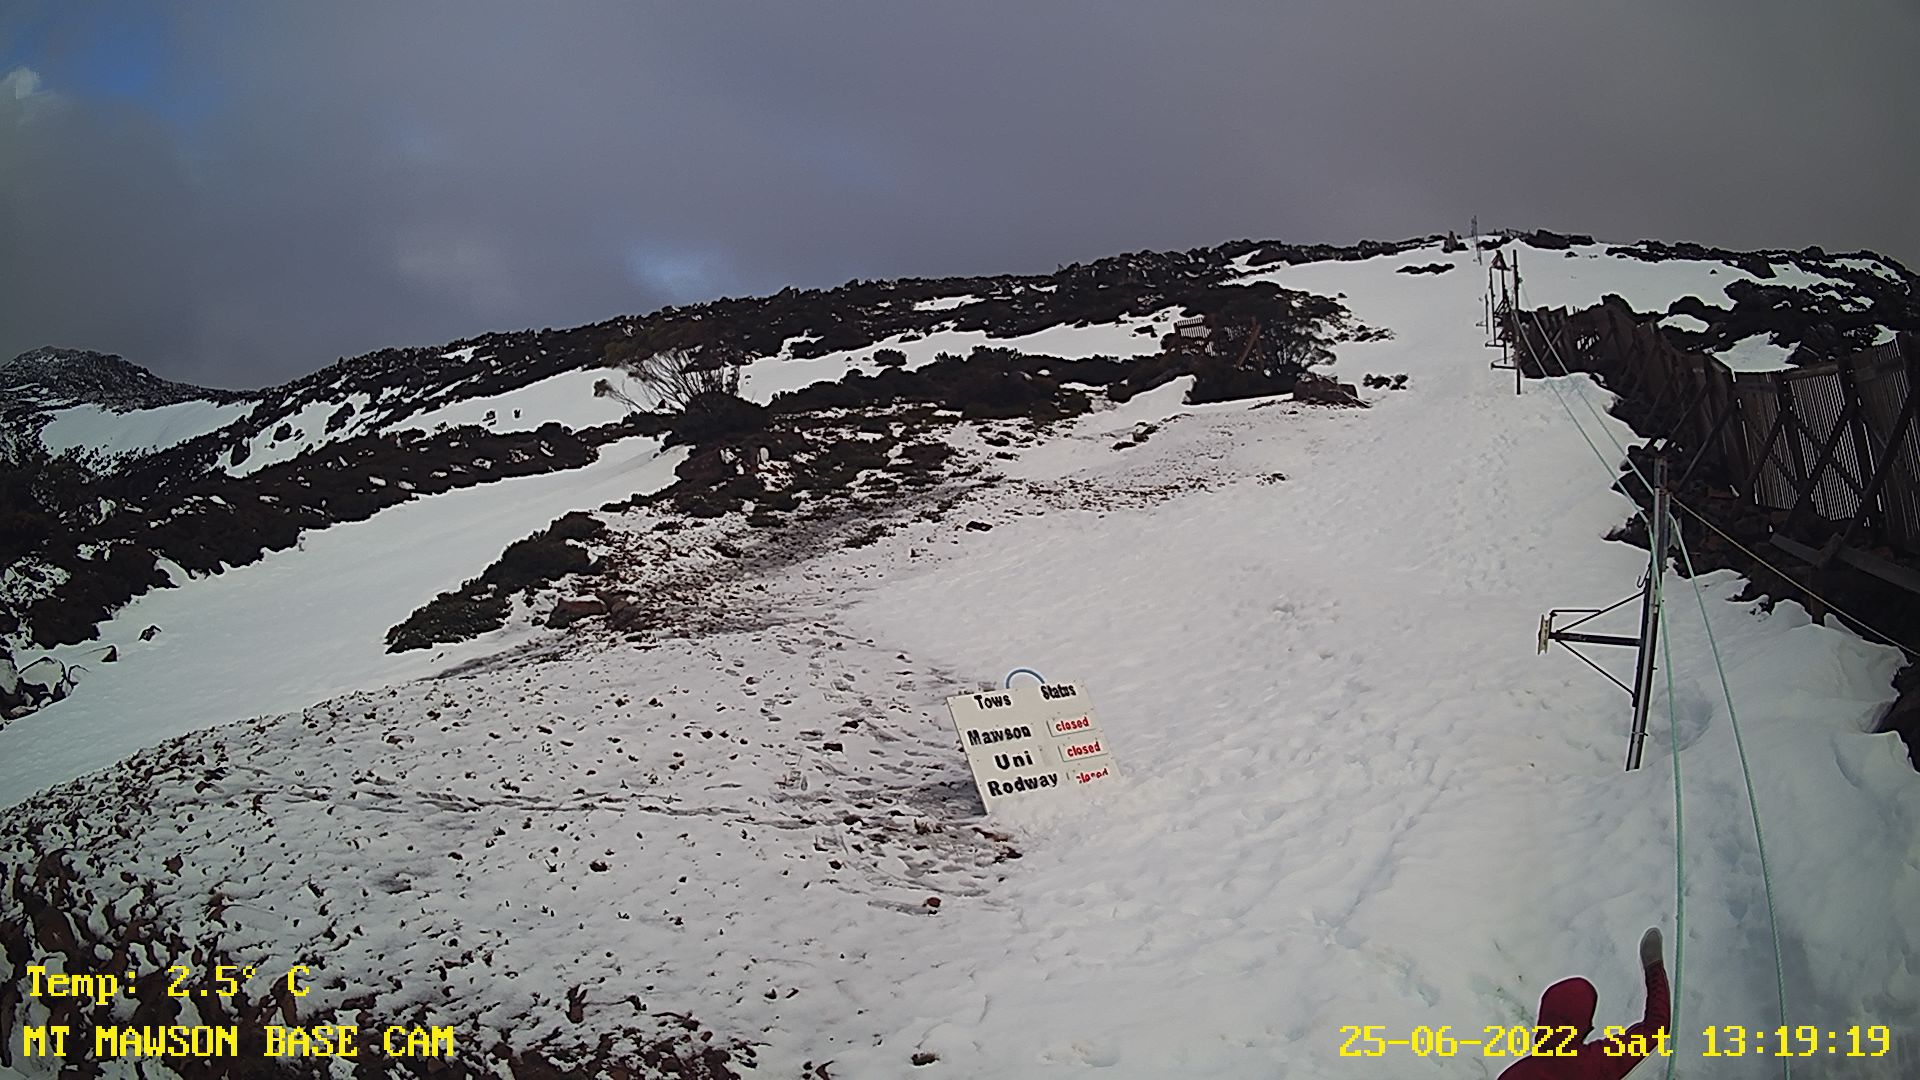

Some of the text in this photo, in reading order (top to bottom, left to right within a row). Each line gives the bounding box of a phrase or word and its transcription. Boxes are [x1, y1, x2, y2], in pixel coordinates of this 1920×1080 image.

[974, 683, 1077, 710] Tows Status
[966, 716, 1090, 746] Mawson closed
[994, 741, 1102, 770] Uni closed
[987, 772, 1058, 797] Rodway
